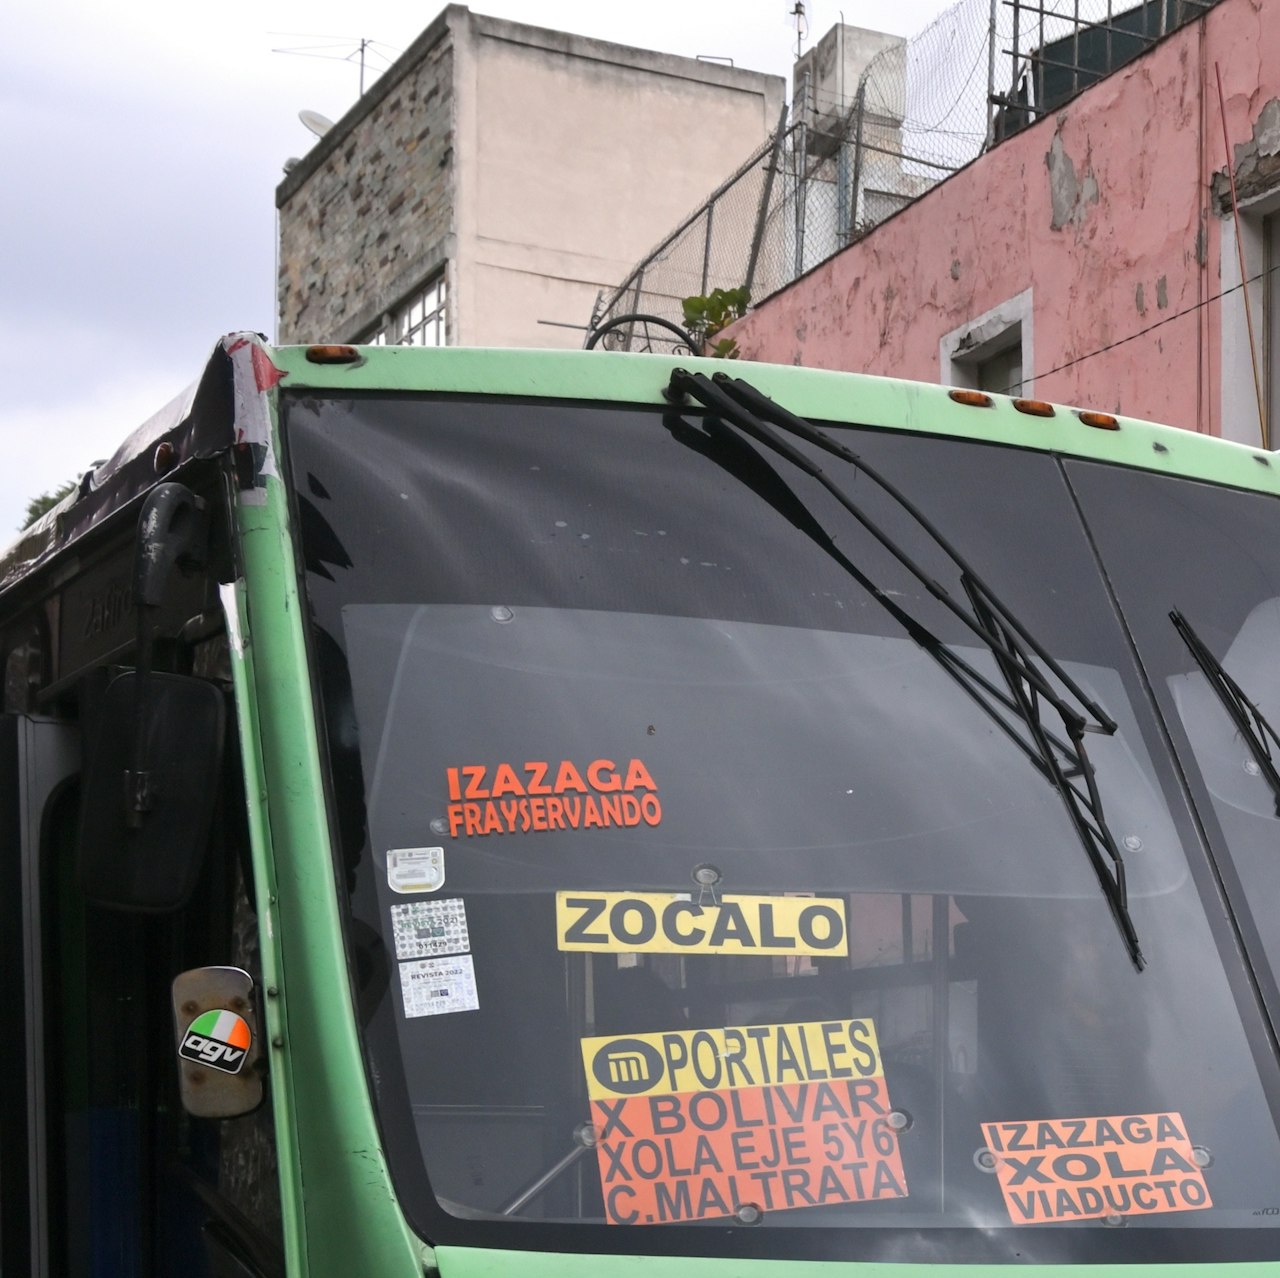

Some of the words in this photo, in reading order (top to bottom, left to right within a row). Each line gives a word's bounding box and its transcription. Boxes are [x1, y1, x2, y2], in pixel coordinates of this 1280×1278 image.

[447, 759, 658, 801] IZAZAGA
[563, 896, 846, 950] ZOCALO
[411, 970, 444, 980] REVISTA
[445, 968, 464, 977] 2022
[184, 1034, 245, 1063] agv
[662, 1019, 878, 1092] PORTALES
[594, 1098, 635, 1138] X
[649, 1078, 887, 1136] BOLIVAR
[987, 1115, 1186, 1151] IZAZAGA
[601, 1134, 723, 1184] XOLA
[730, 1125, 812, 1171] EJE
[1004, 1147, 1197, 1186] XOLA
[1009, 1178, 1207, 1220] VIADUCTO
